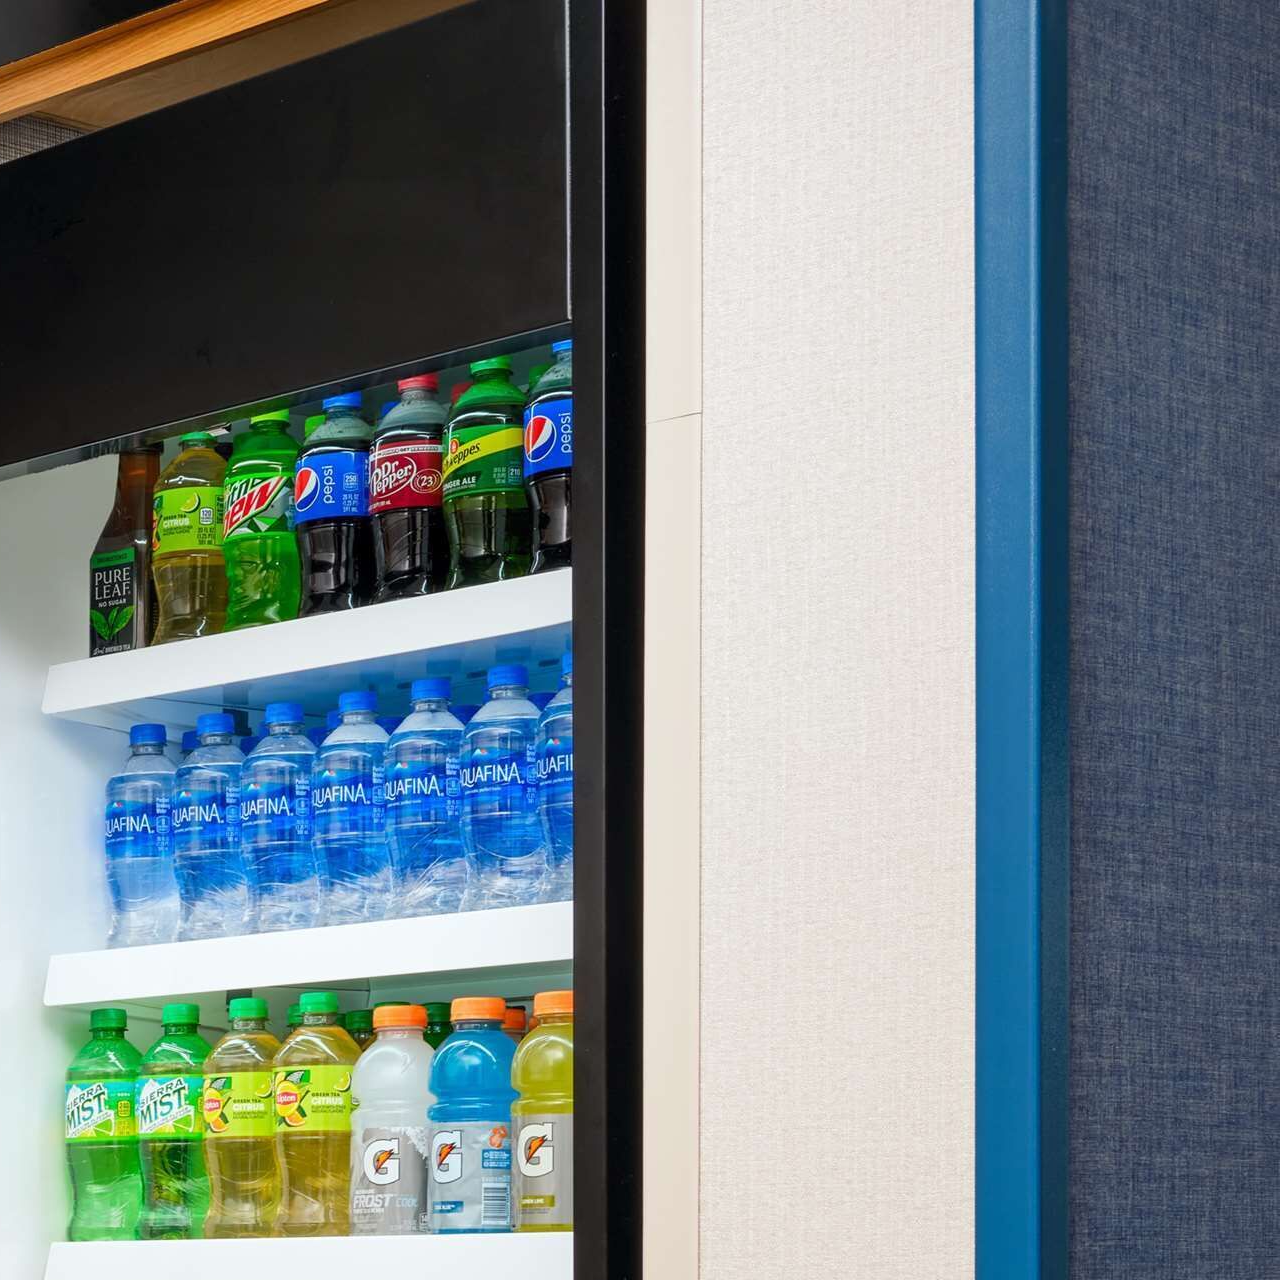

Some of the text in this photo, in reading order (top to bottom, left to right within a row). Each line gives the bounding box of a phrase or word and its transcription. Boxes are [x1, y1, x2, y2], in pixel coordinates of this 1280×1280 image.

[559, 412, 572, 453] pepsi
[371, 465, 413, 496] Pepper
[382, 461, 399, 477] Dr
[462, 476, 476, 484] ALE
[322, 465, 336, 504] pepsi
[421, 476, 433, 487] 23
[162, 518, 190, 528] CITRUS
[95, 567, 131, 586] PURE
[95, 582, 131, 600] LEAF
[312, 783, 371, 807] QUAFINA
[385, 775, 444, 800] QUAFINA
[141, 1086, 185, 1125] MIST
[142, 1079, 183, 1109] SIERRA
[311, 1097, 342, 1105] CITRUS
[67, 1091, 105, 1129] MIST
[233, 1103, 264, 1111] CITRUS
[363, 1137, 401, 1186] G
[432, 1129, 463, 1184] G
[517, 1121, 555, 1178] G
[353, 1194, 392, 1208] FROST
